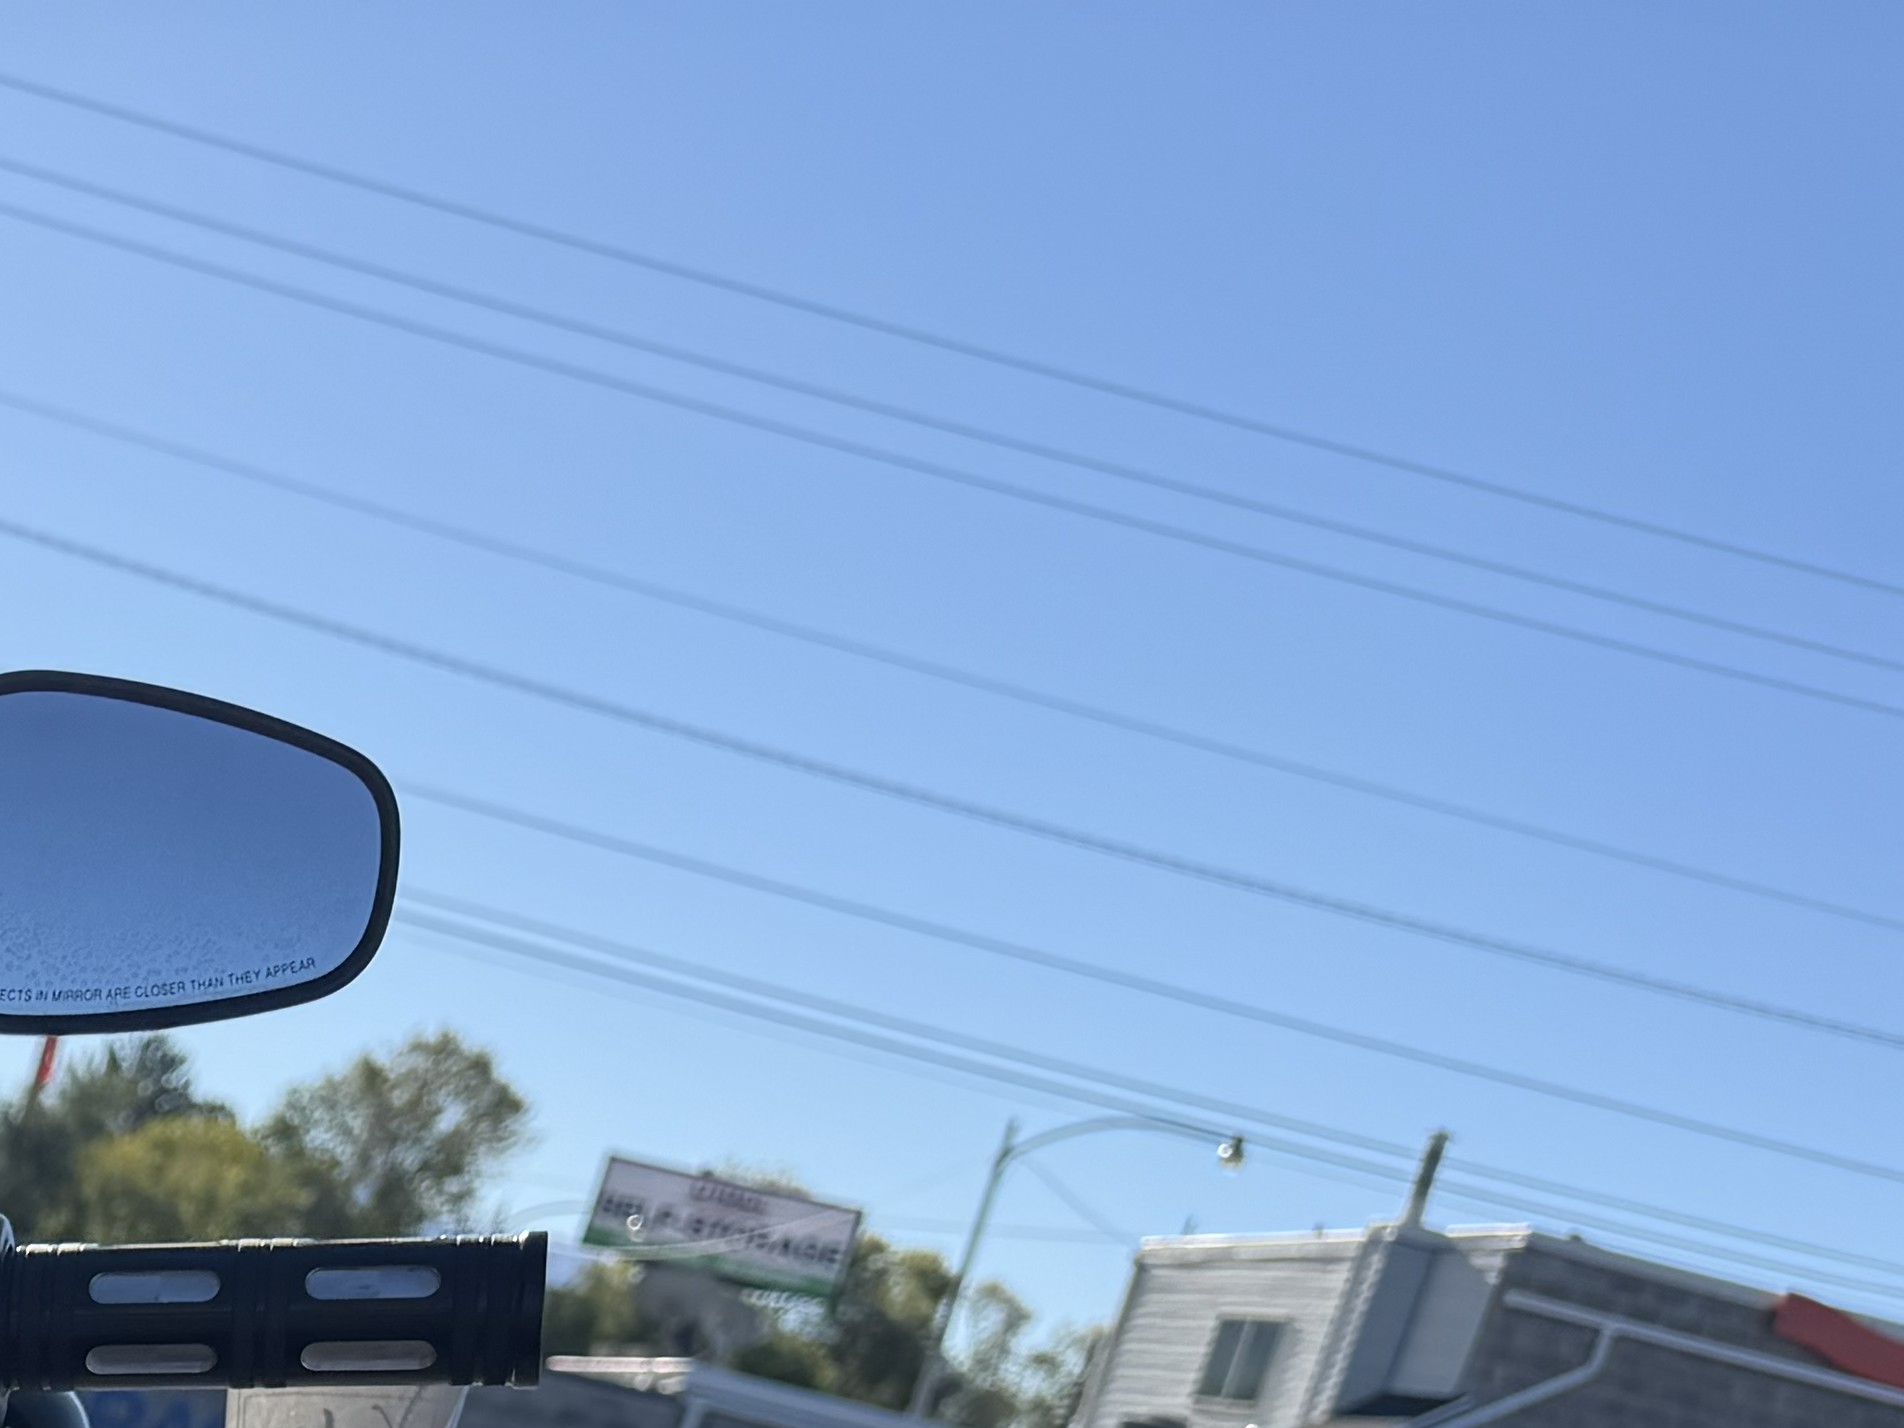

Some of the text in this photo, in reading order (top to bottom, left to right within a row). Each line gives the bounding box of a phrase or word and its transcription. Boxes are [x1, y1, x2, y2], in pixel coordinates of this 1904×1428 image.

[35, 989, 49, 1002] IN
[52, 988, 103, 1003] MIRROR
[105, 985, 131, 1001] ARE
[134, 980, 186, 999] CLOSER
[190, 975, 224, 992] THAN
[228, 969, 261, 986] THEY
[265, 956, 316, 980] APPEAR
